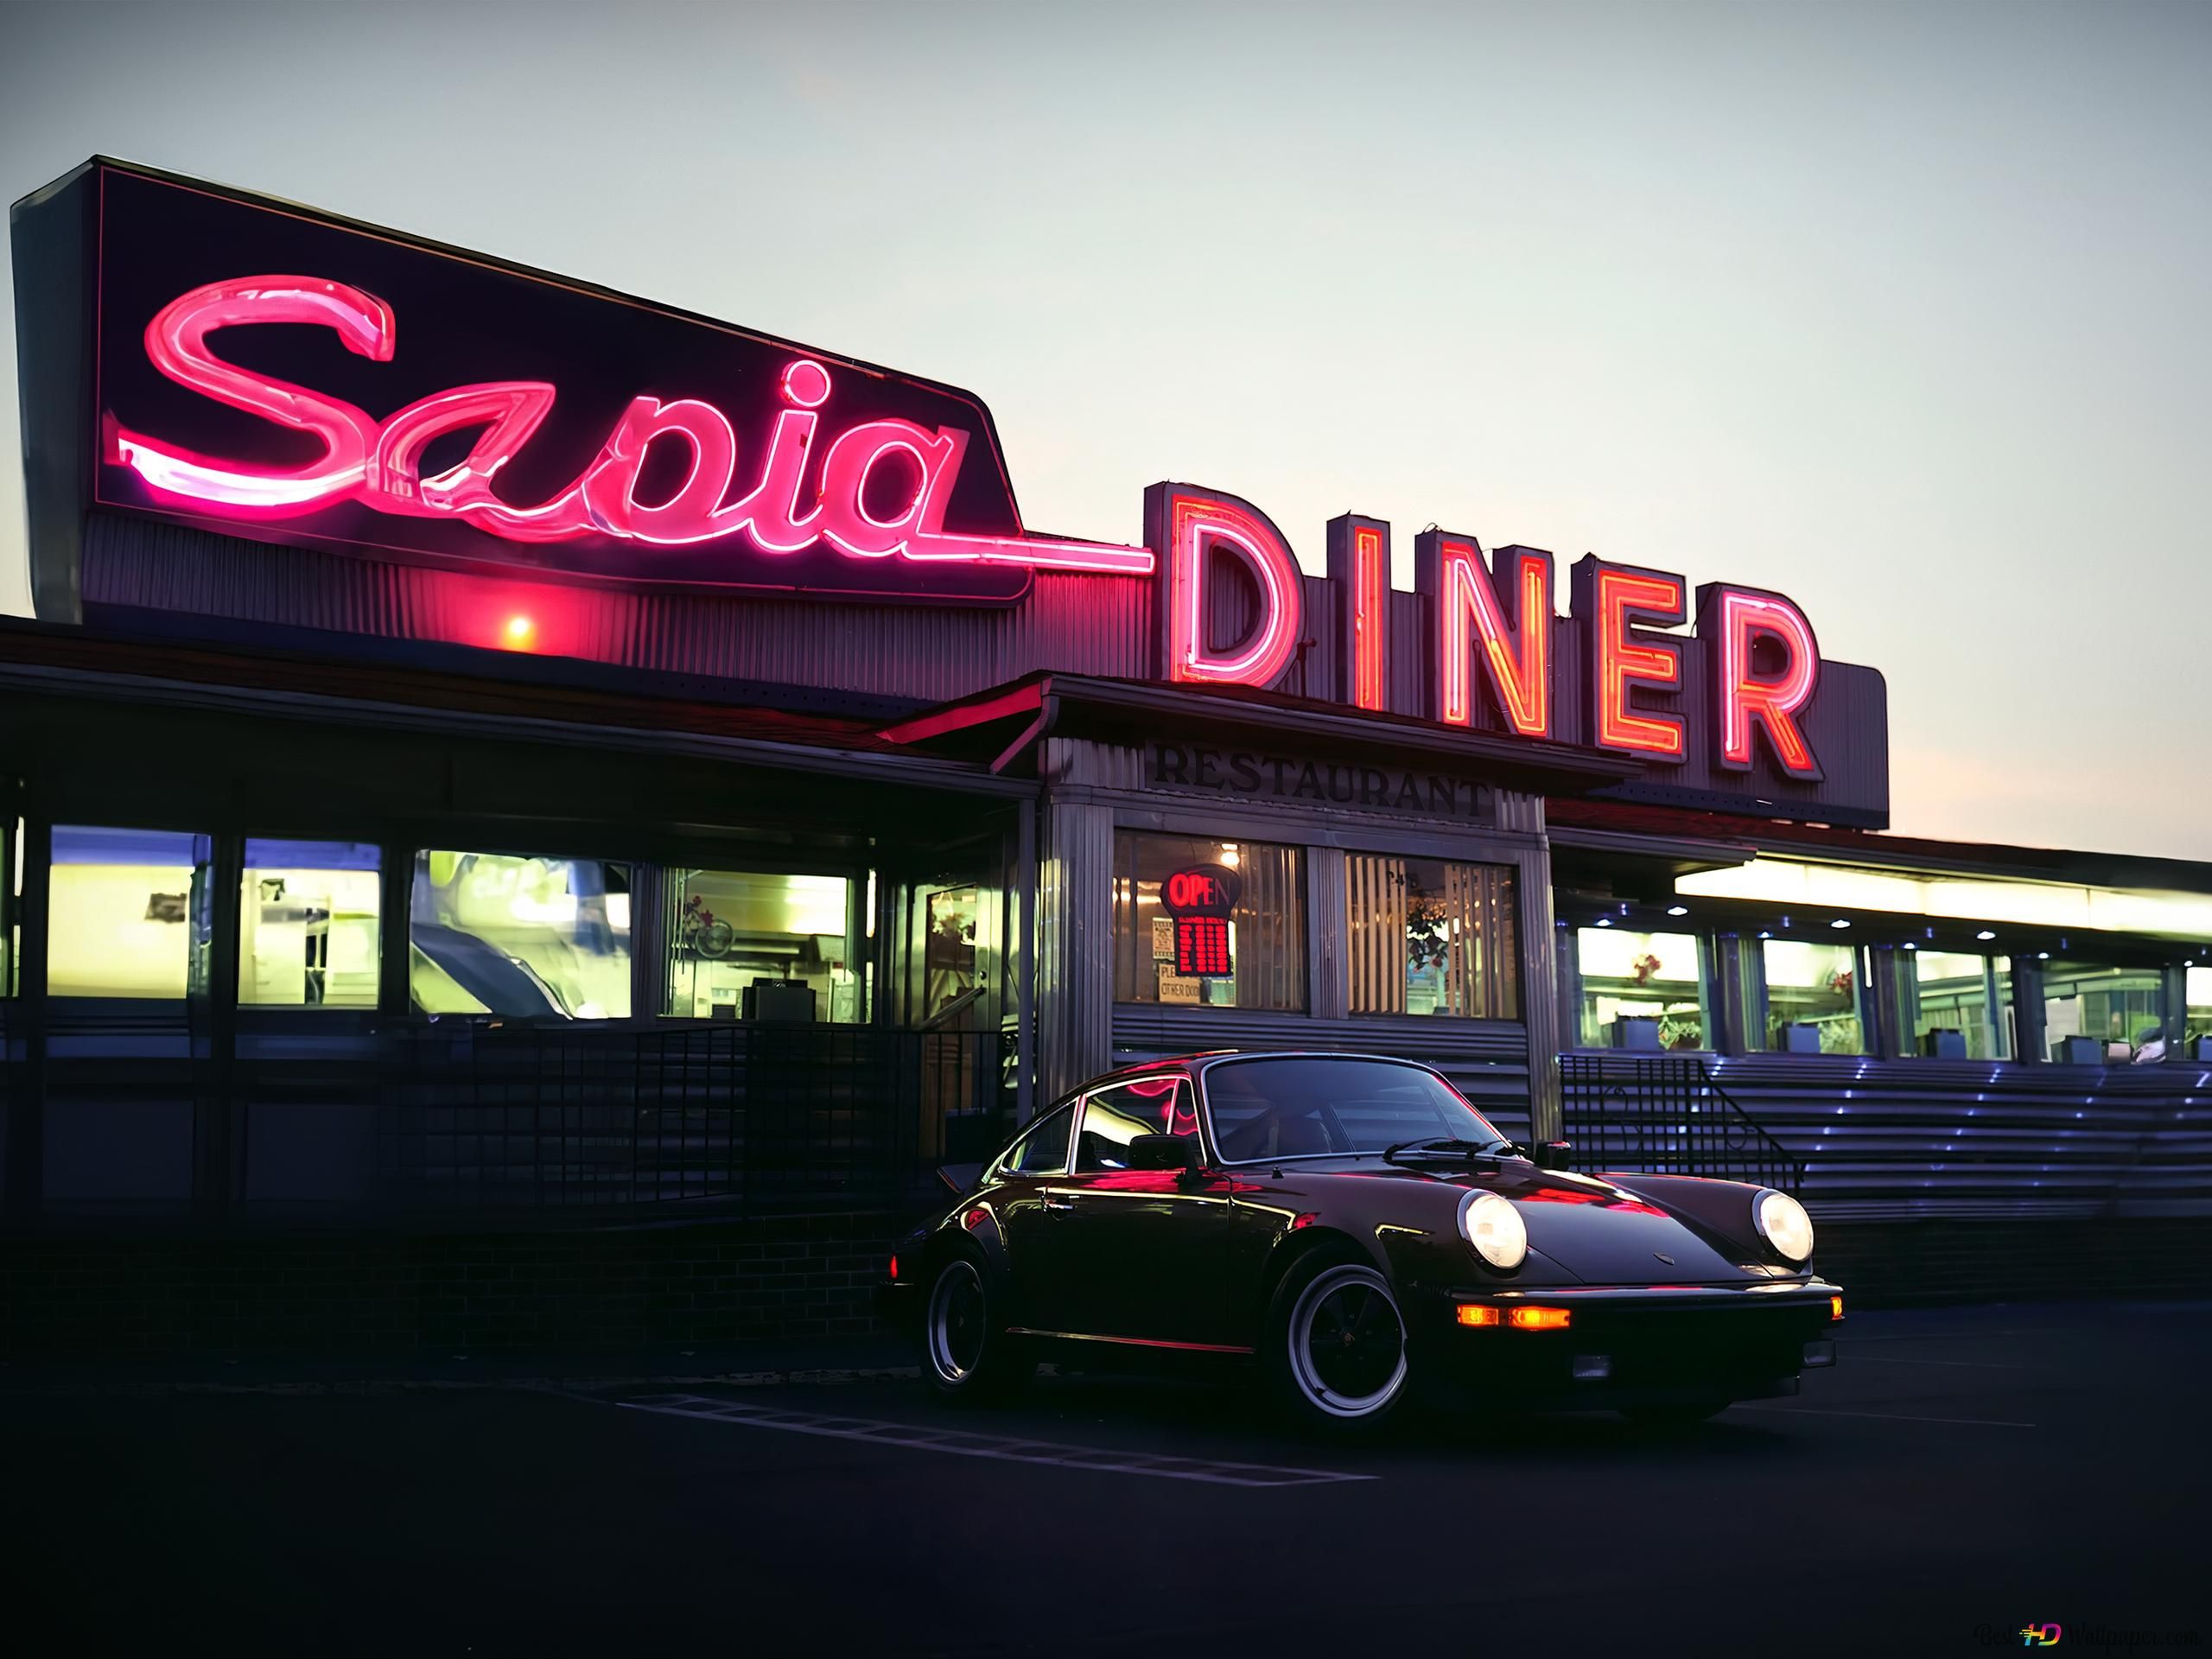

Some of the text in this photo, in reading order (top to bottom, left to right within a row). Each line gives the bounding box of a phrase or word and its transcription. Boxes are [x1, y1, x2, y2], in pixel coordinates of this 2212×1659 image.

[1165, 487, 1823, 779] DINER
[1155, 743, 1490, 817] RESTAURANT
[1168, 872, 1230, 908] OPEN
